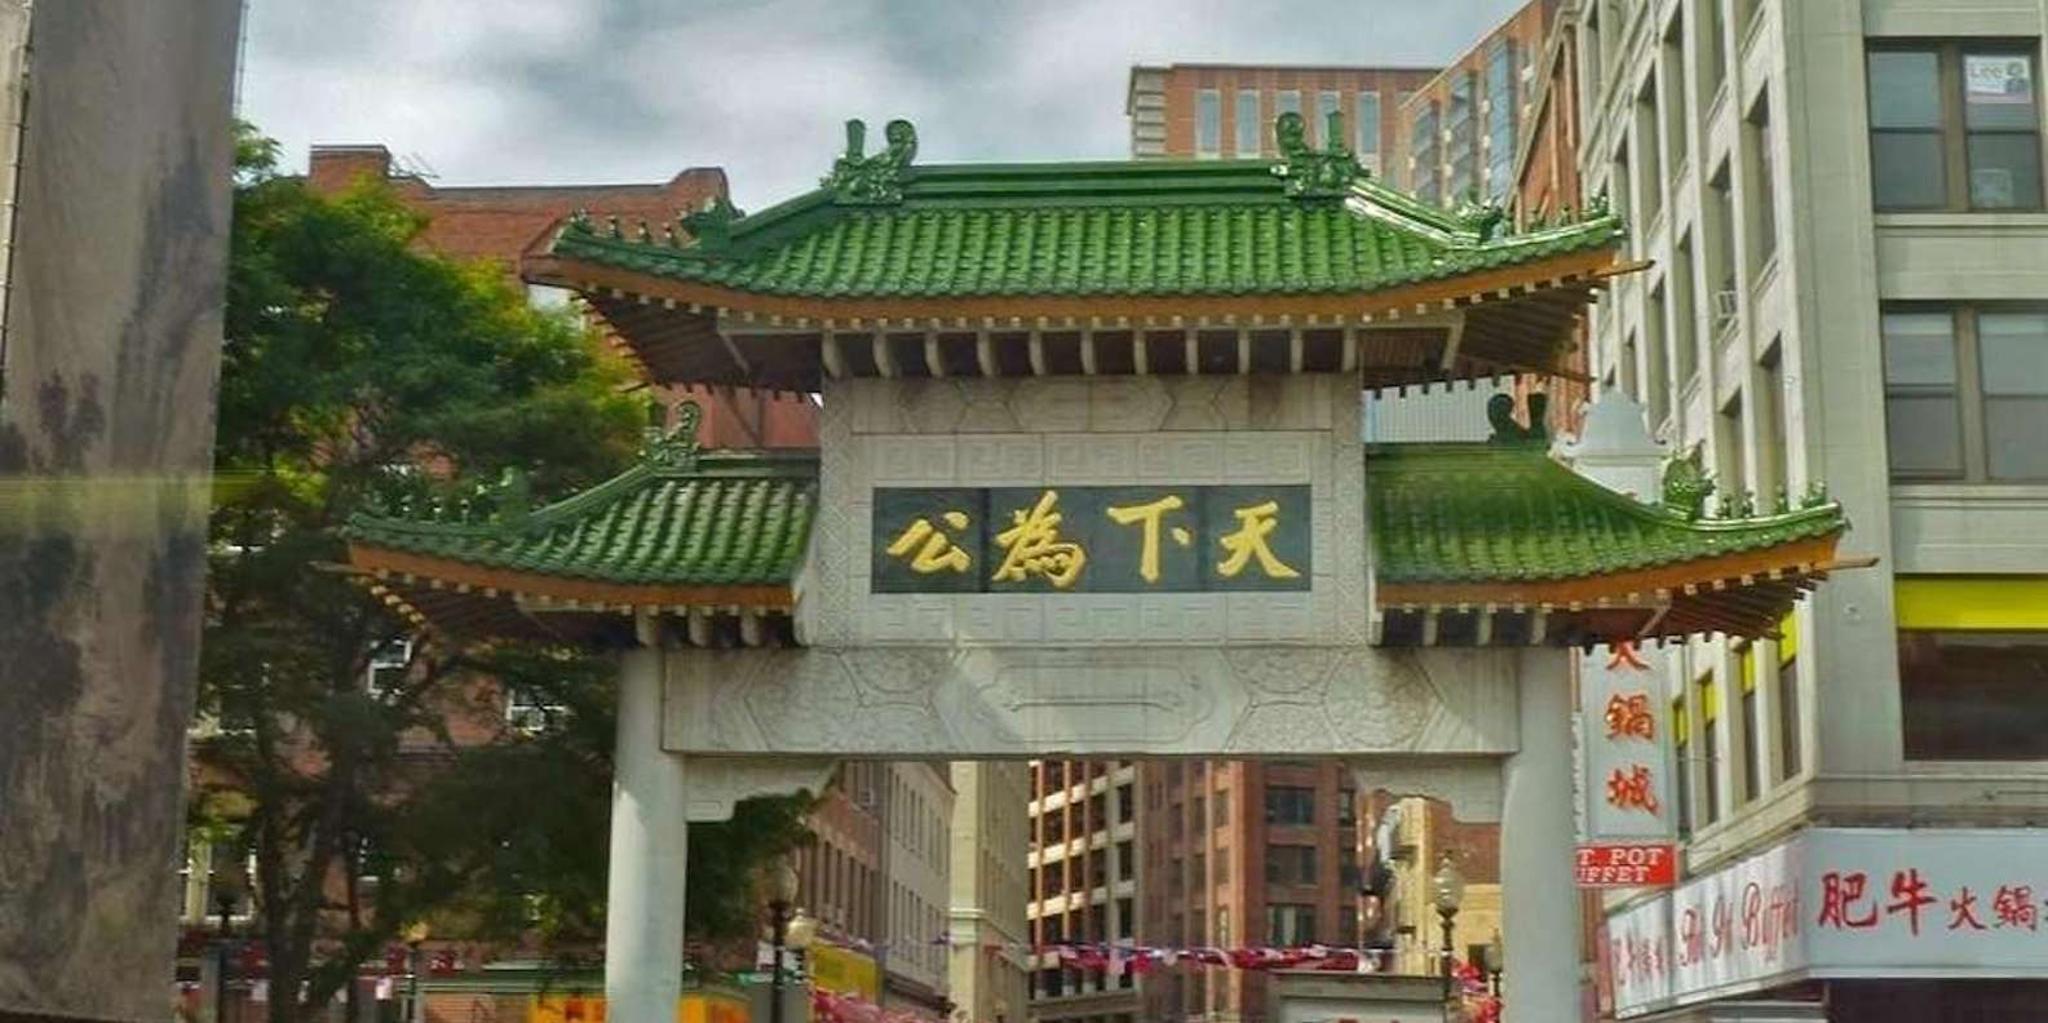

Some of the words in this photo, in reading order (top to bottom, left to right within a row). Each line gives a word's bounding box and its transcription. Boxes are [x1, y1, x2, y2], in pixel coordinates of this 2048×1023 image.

[1610, 848, 1664, 866] POT
[1818, 868, 2048, 936] 肥牛火鍋
